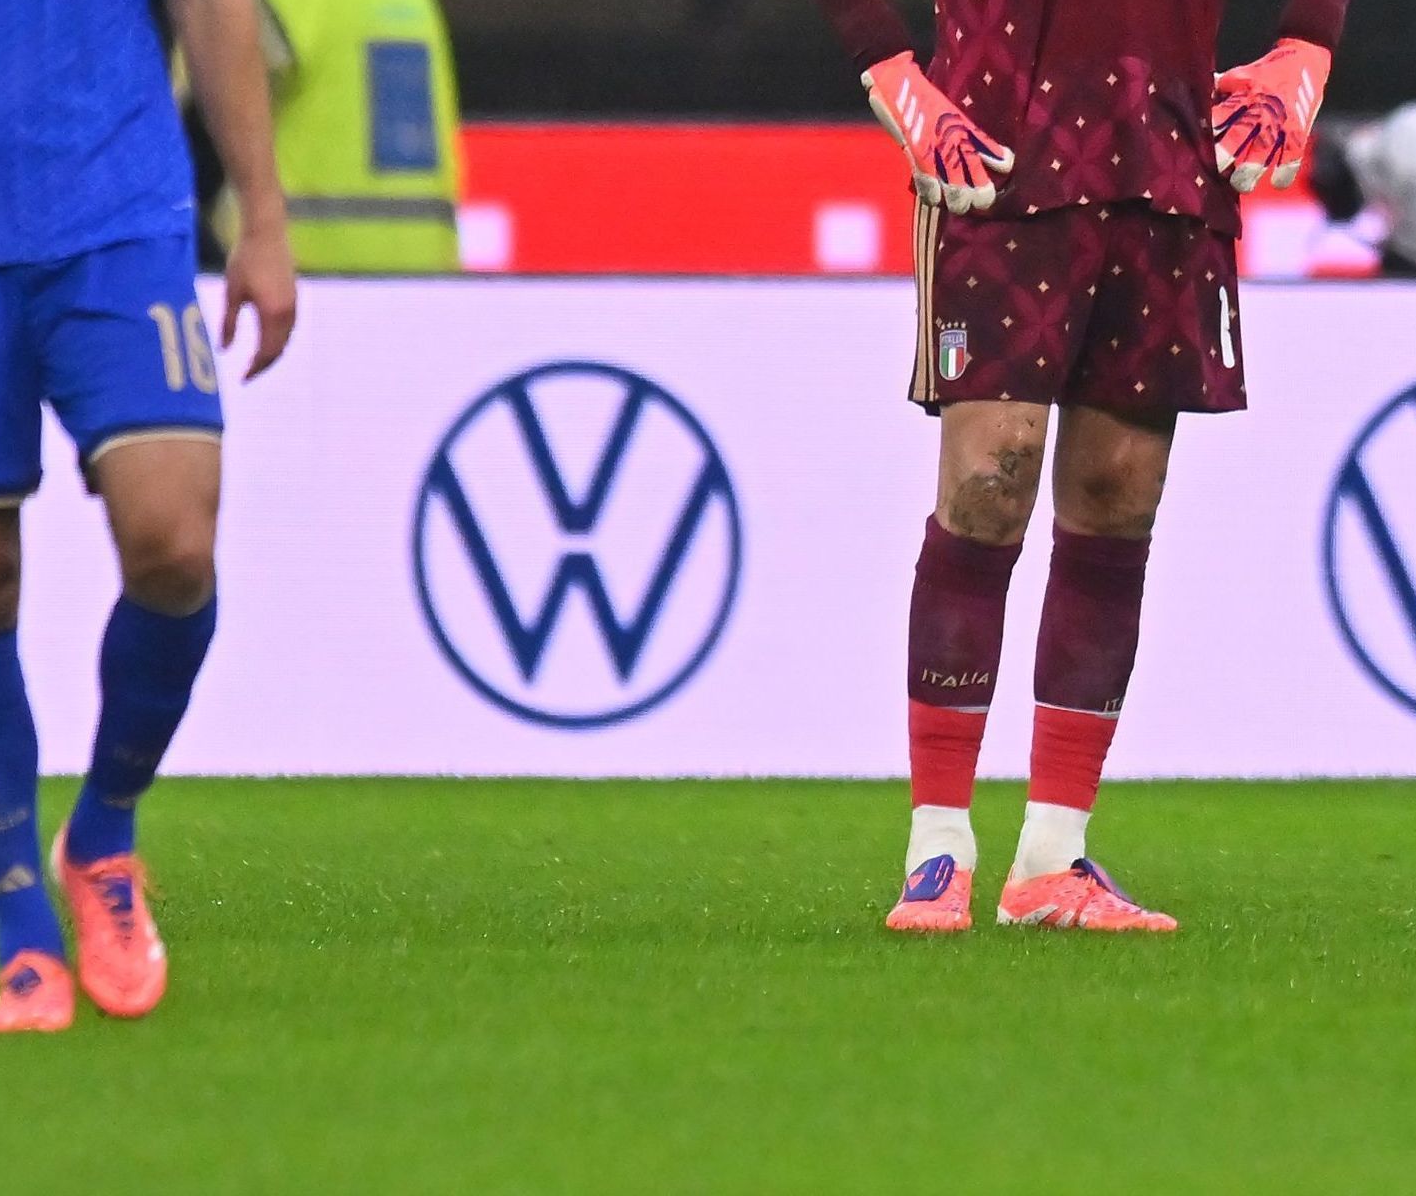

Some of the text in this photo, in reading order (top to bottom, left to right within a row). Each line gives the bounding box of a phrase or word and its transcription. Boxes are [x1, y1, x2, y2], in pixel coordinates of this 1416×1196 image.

[1219, 286, 1235, 368] 1
[423, 369, 733, 699] VW
[922, 668, 989, 688] ITALIA
